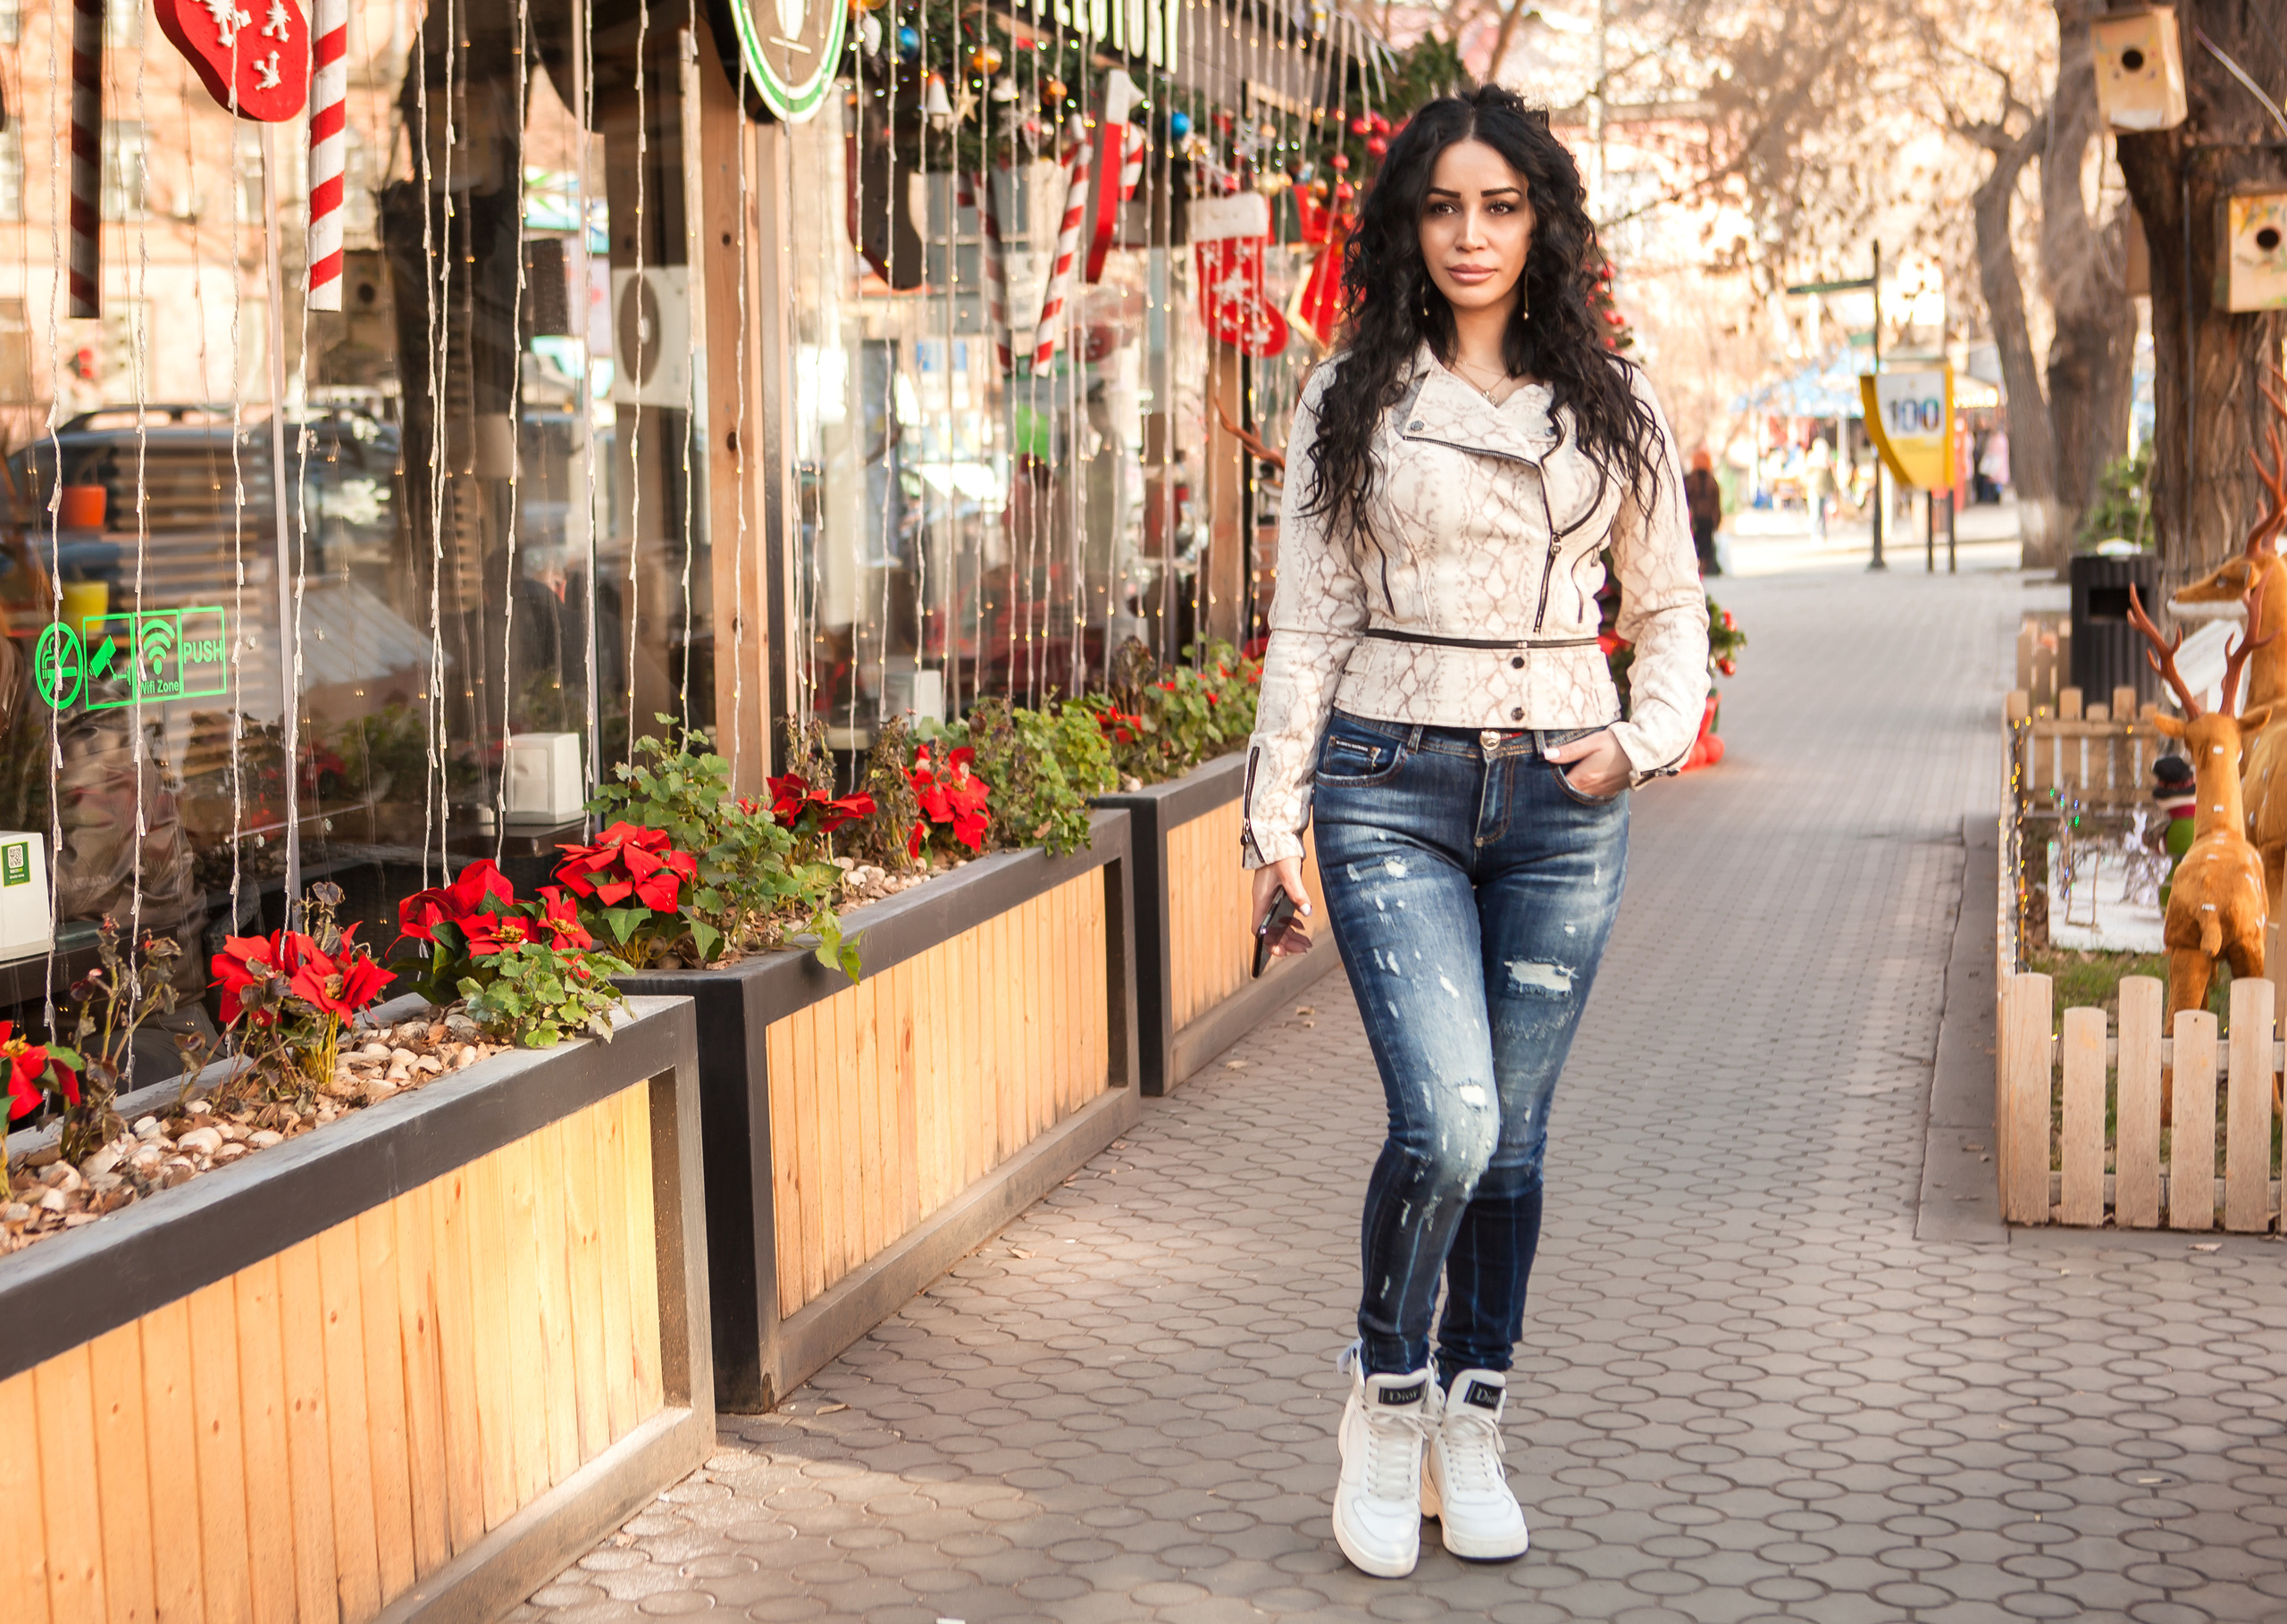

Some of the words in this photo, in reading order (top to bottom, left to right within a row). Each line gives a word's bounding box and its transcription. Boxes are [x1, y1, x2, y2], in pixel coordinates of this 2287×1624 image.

[1889, 397, 1939, 432] 100
[183, 640, 223, 664] PUSH
[157, 679, 180, 693] Zone
[1388, 1389, 1420, 1402] Dior
